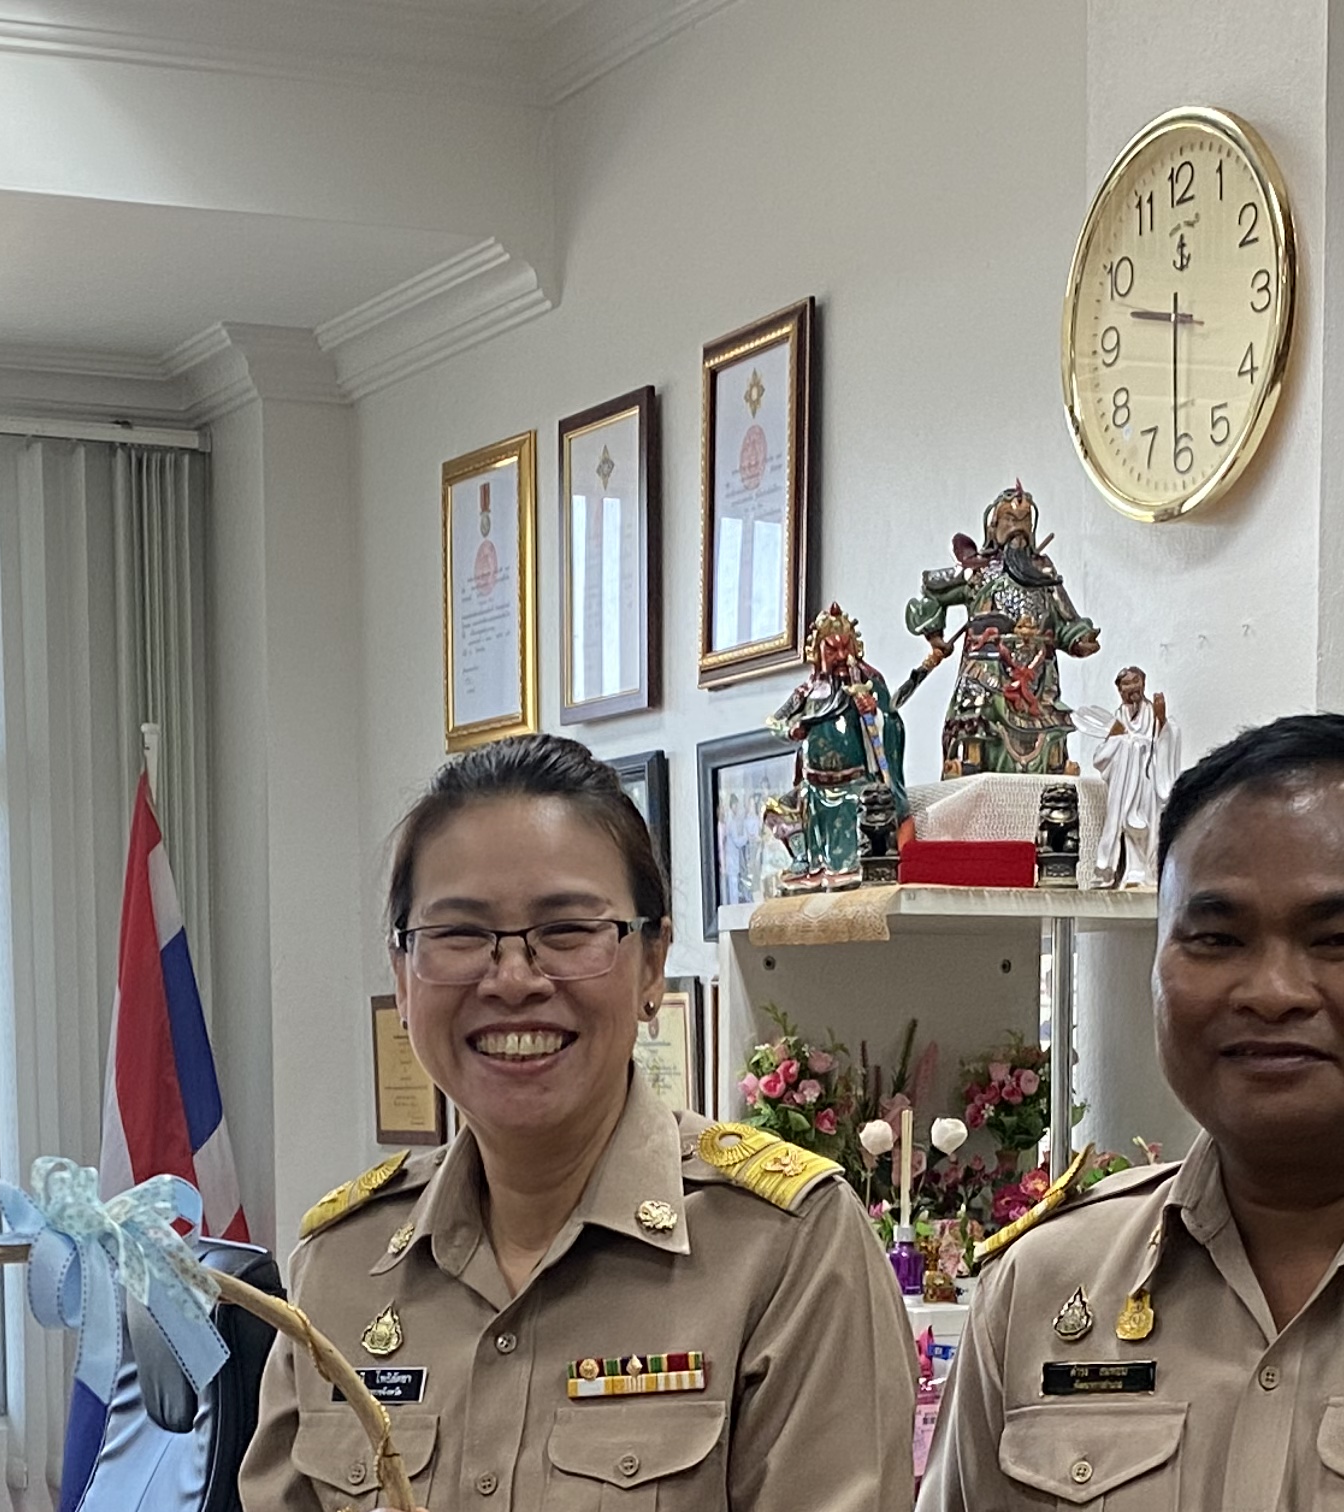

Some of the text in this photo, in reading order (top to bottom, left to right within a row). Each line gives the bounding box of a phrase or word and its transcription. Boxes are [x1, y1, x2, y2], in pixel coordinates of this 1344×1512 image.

[1167, 160, 1196, 207] 12
[1215, 158, 1224, 201] 1
[1133, 190, 1155, 236] 11
[1237, 201, 1260, 248] 2
[1106, 255, 1135, 302] 10
[1249, 268, 1272, 313] 3
[1100, 325, 1121, 368] 9
[1237, 341, 1260, 385] 4
[1111, 387, 1131, 428] 8
[1209, 402, 1231, 447] 5
[1139, 426, 1159, 470] 7
[1173, 432, 1194, 475] 6
